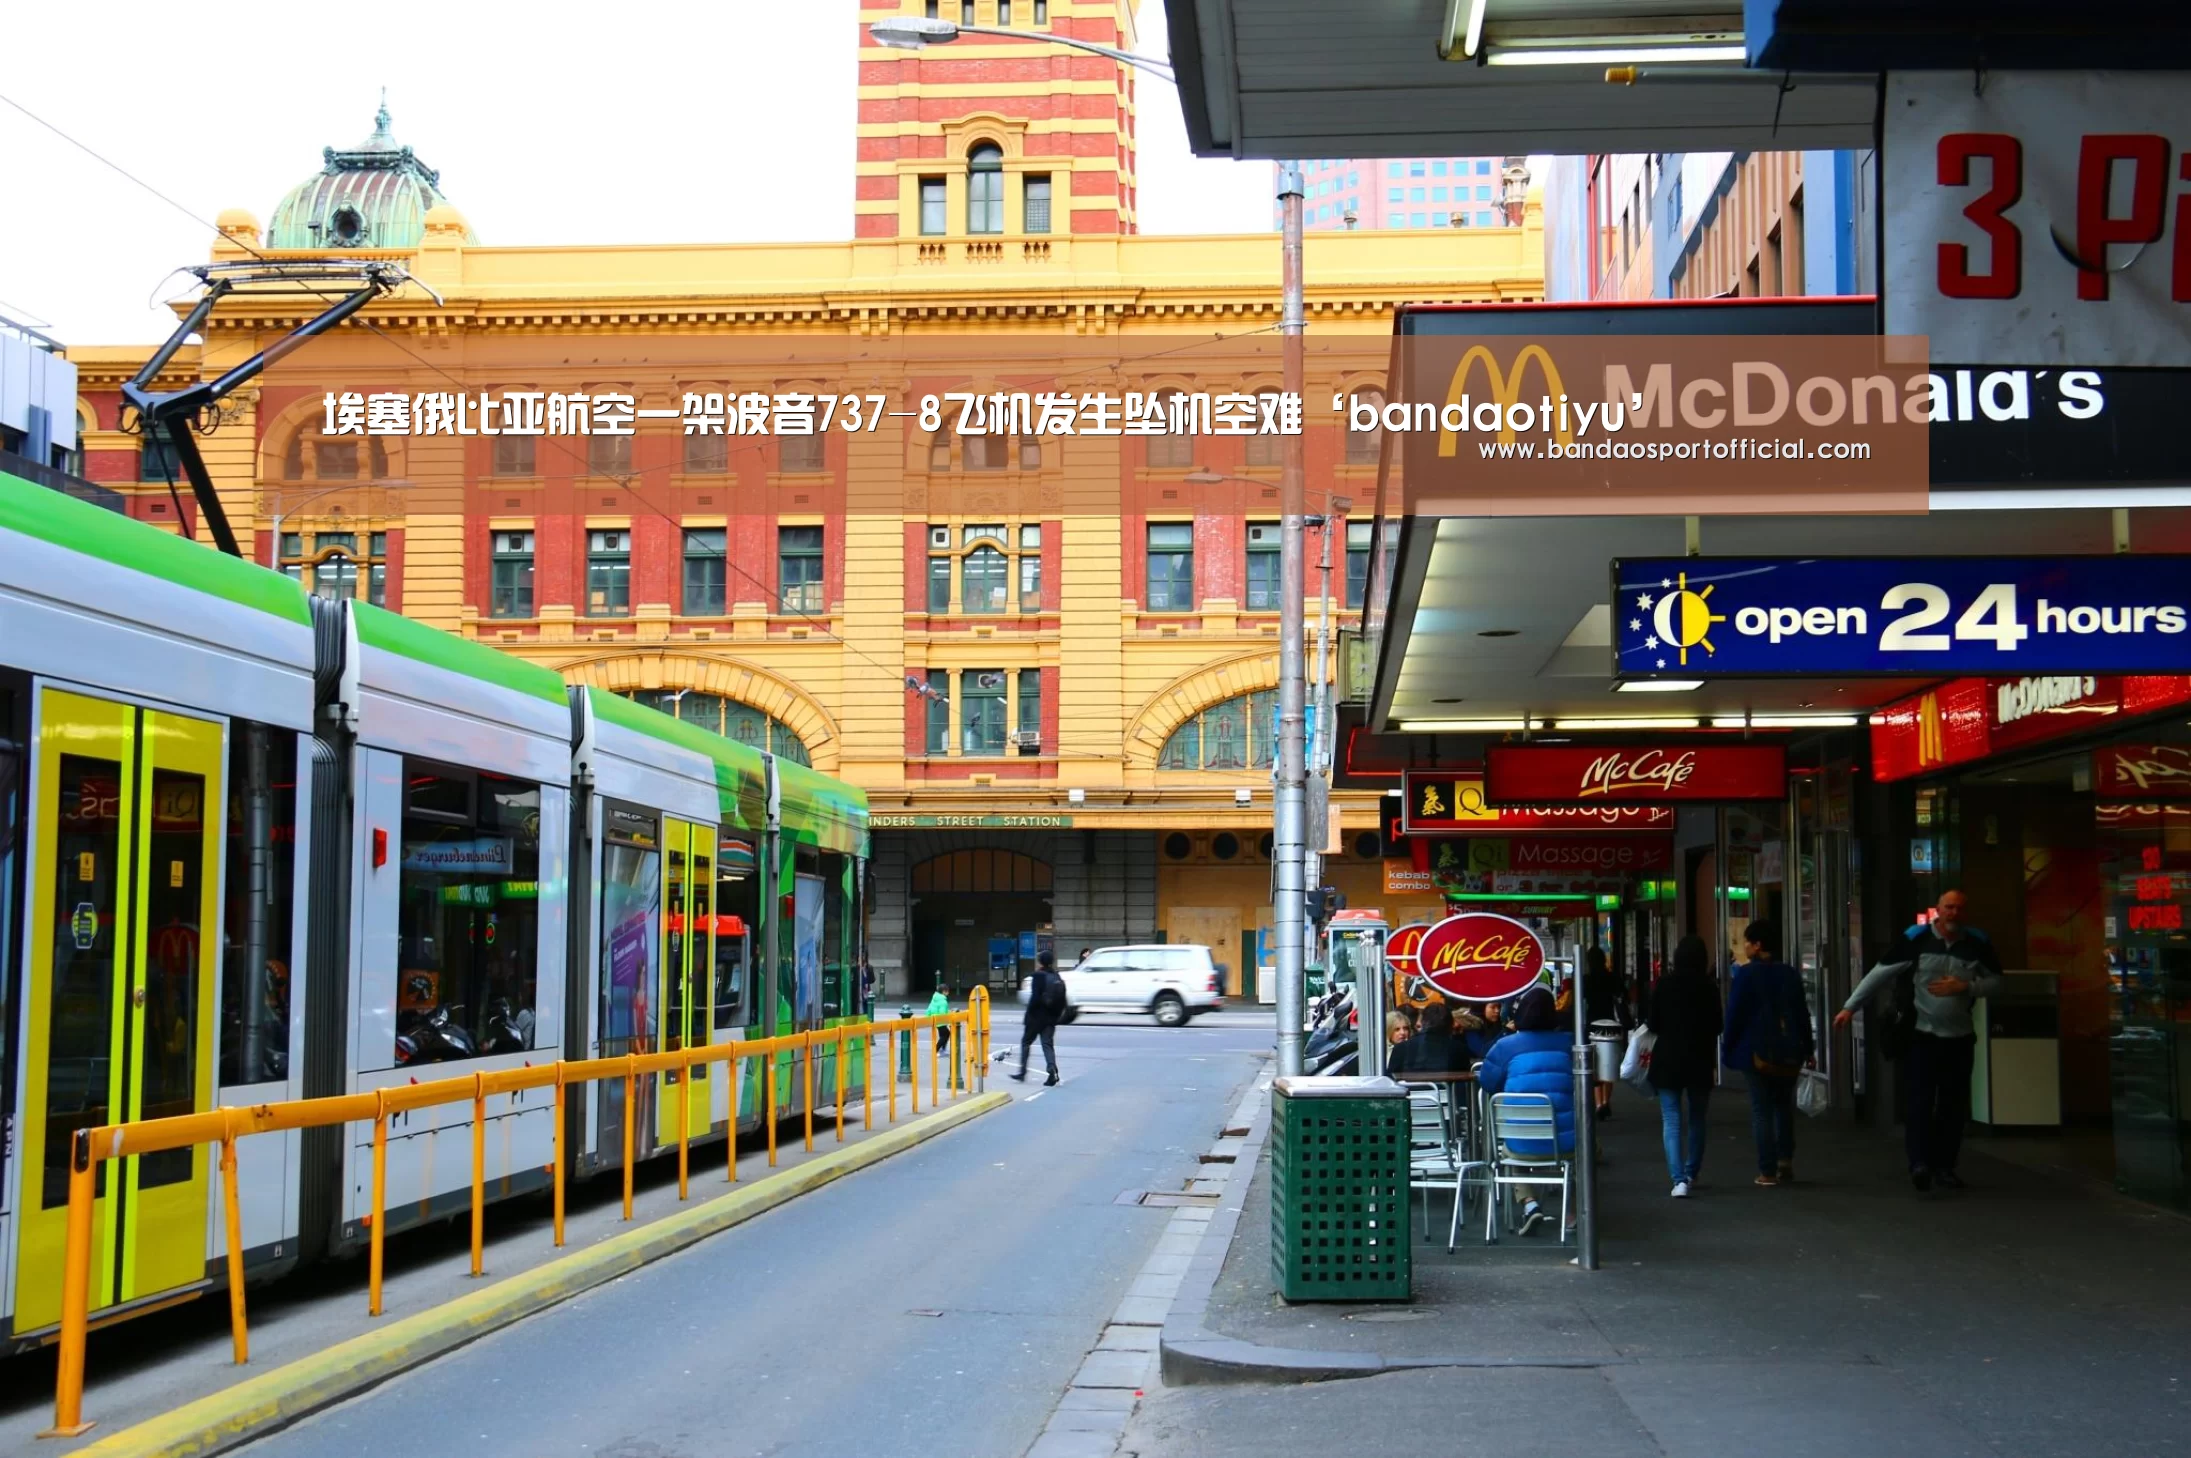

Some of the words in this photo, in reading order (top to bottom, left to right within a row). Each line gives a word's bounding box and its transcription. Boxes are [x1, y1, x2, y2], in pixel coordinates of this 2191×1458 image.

[1937, 133, 2022, 299] 3
[1735, 606, 1867, 643] open
[1879, 583, 2028, 651] 24
[2036, 599, 2187, 634] hours
[1581, 749, 1695, 794] McCafé
[1459, 786, 1486, 816] Q
[869, 816, 916, 827] INDERS
[937, 816, 984, 827] STREET
[1003, 816, 1061, 827] STATION
[1518, 843, 1634, 868] Massage
[1388, 870, 1430, 879] kebab
[1388, 881, 1431, 890] combo
[1432, 935, 1531, 974] McCafé
